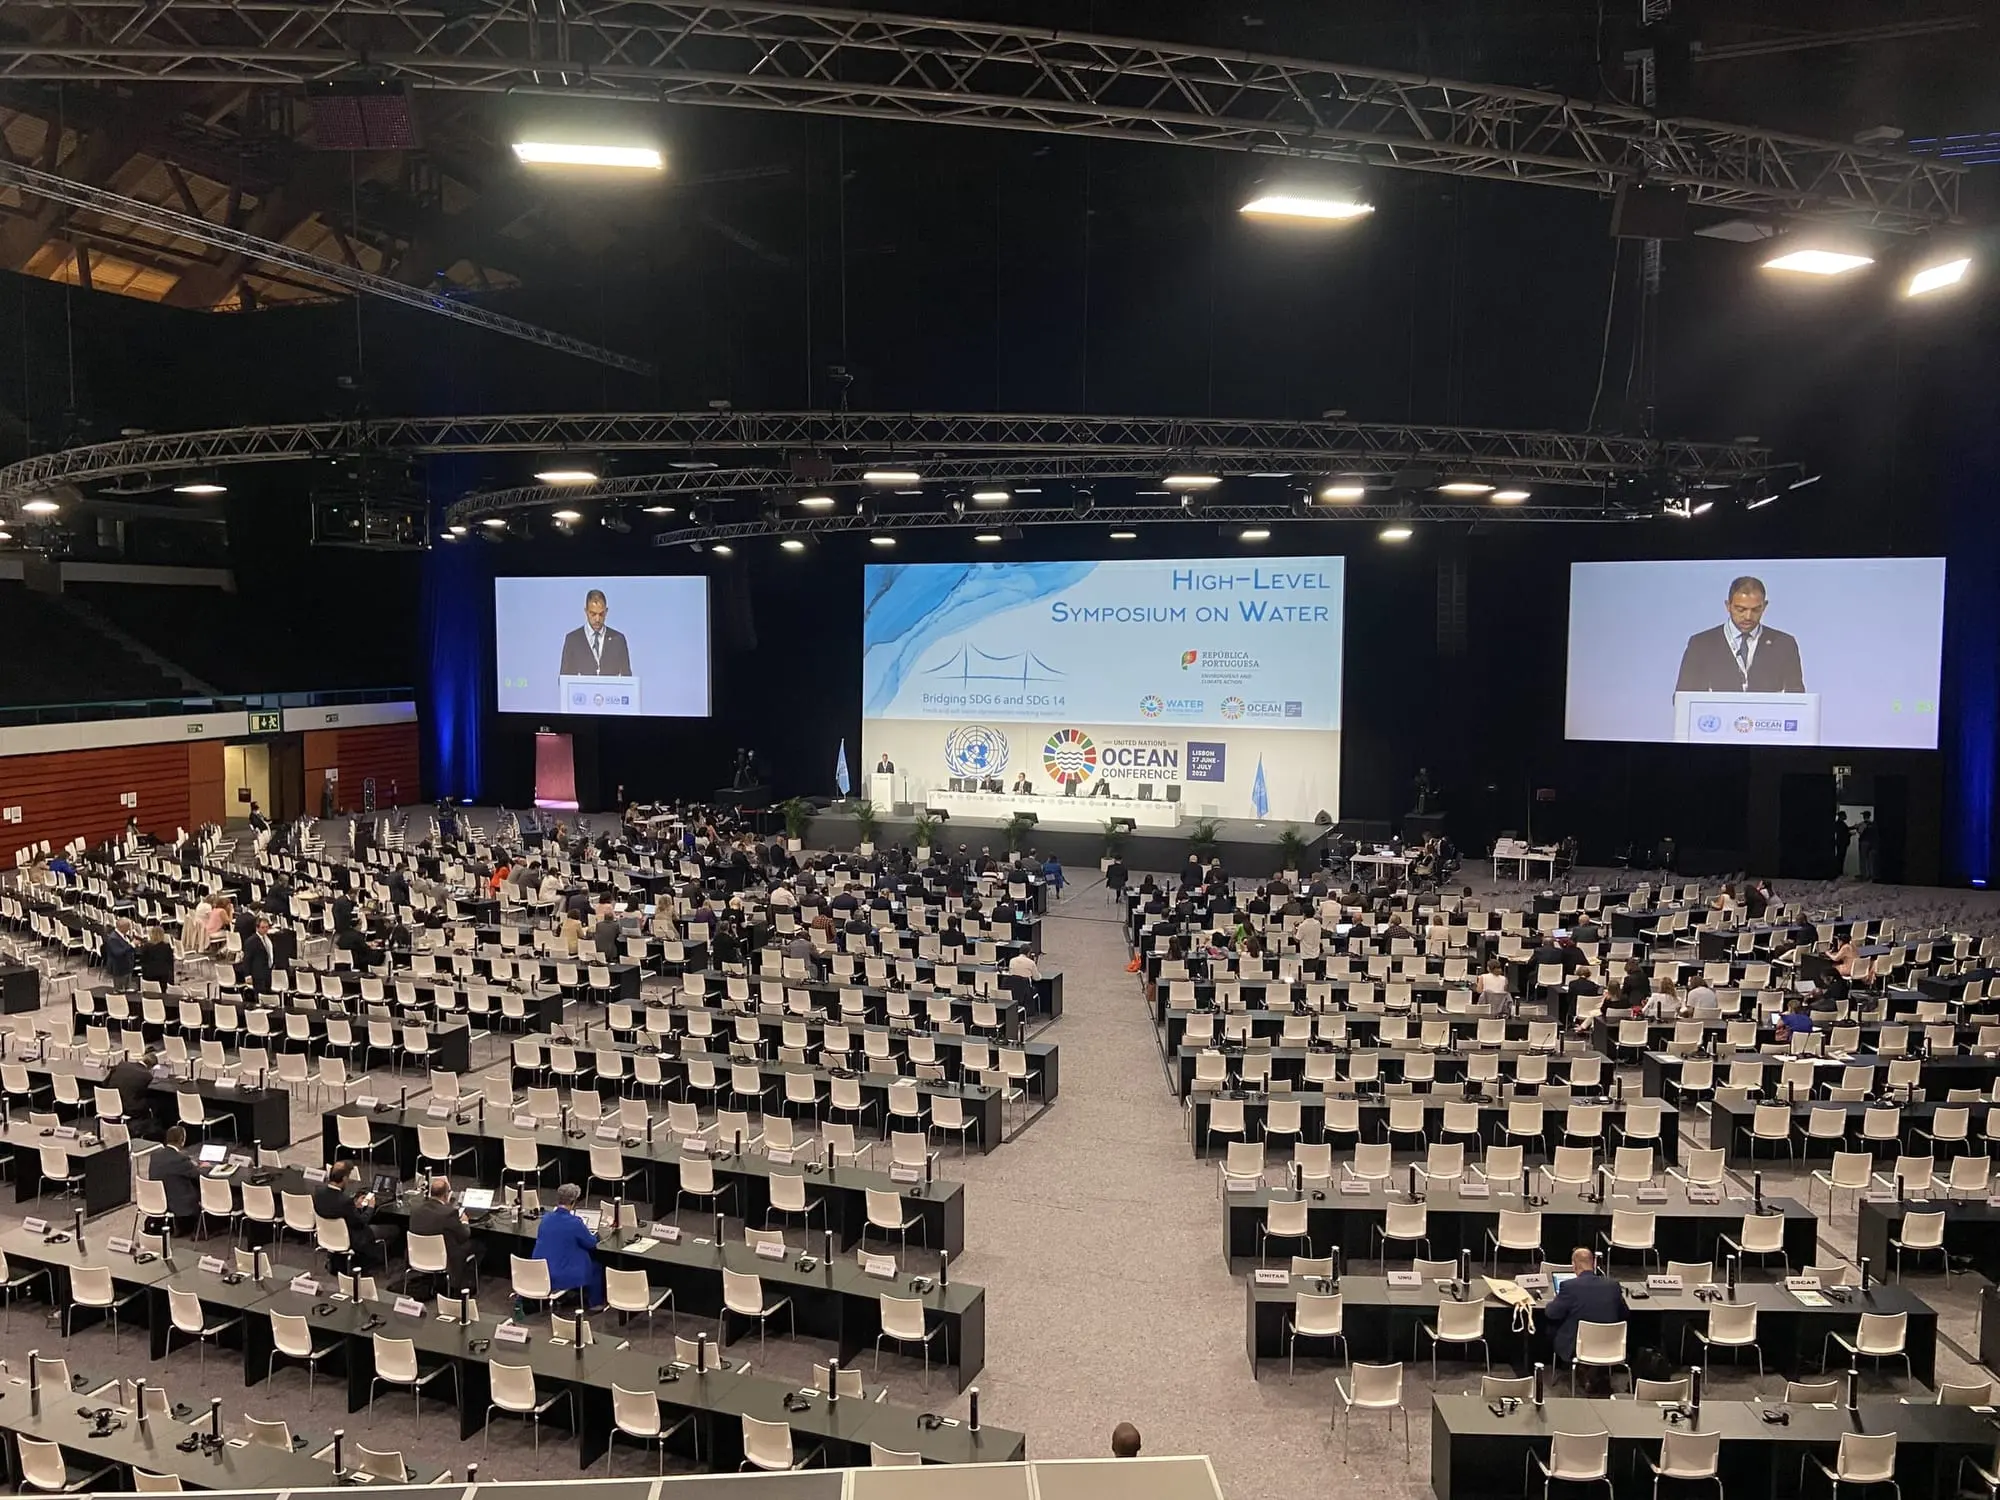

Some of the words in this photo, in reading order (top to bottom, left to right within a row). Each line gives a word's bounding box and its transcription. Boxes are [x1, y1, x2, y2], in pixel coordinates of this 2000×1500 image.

[1051, 602, 1186, 623] SYMPOSIUM
[1195, 606, 1229, 623] ON
[1239, 600, 1329, 622] WATER
[1202, 649, 1249, 659] REPÚBLICA
[1202, 660, 1260, 668] PORTUGUESA
[923, 693, 967, 706] Bridging
[969, 694, 992, 704] SDG
[994, 694, 1001, 704] 6
[1003, 694, 1024, 705] and
[1026, 695, 1050, 705] SDG
[1053, 695, 1066, 706] 14
[1166, 699, 1204, 709] WATER
[1247, 703, 1282, 712] OCEAN
[1101, 748, 1178, 768] OCEAN
[1101, 768, 1178, 780] CONFERENCE
